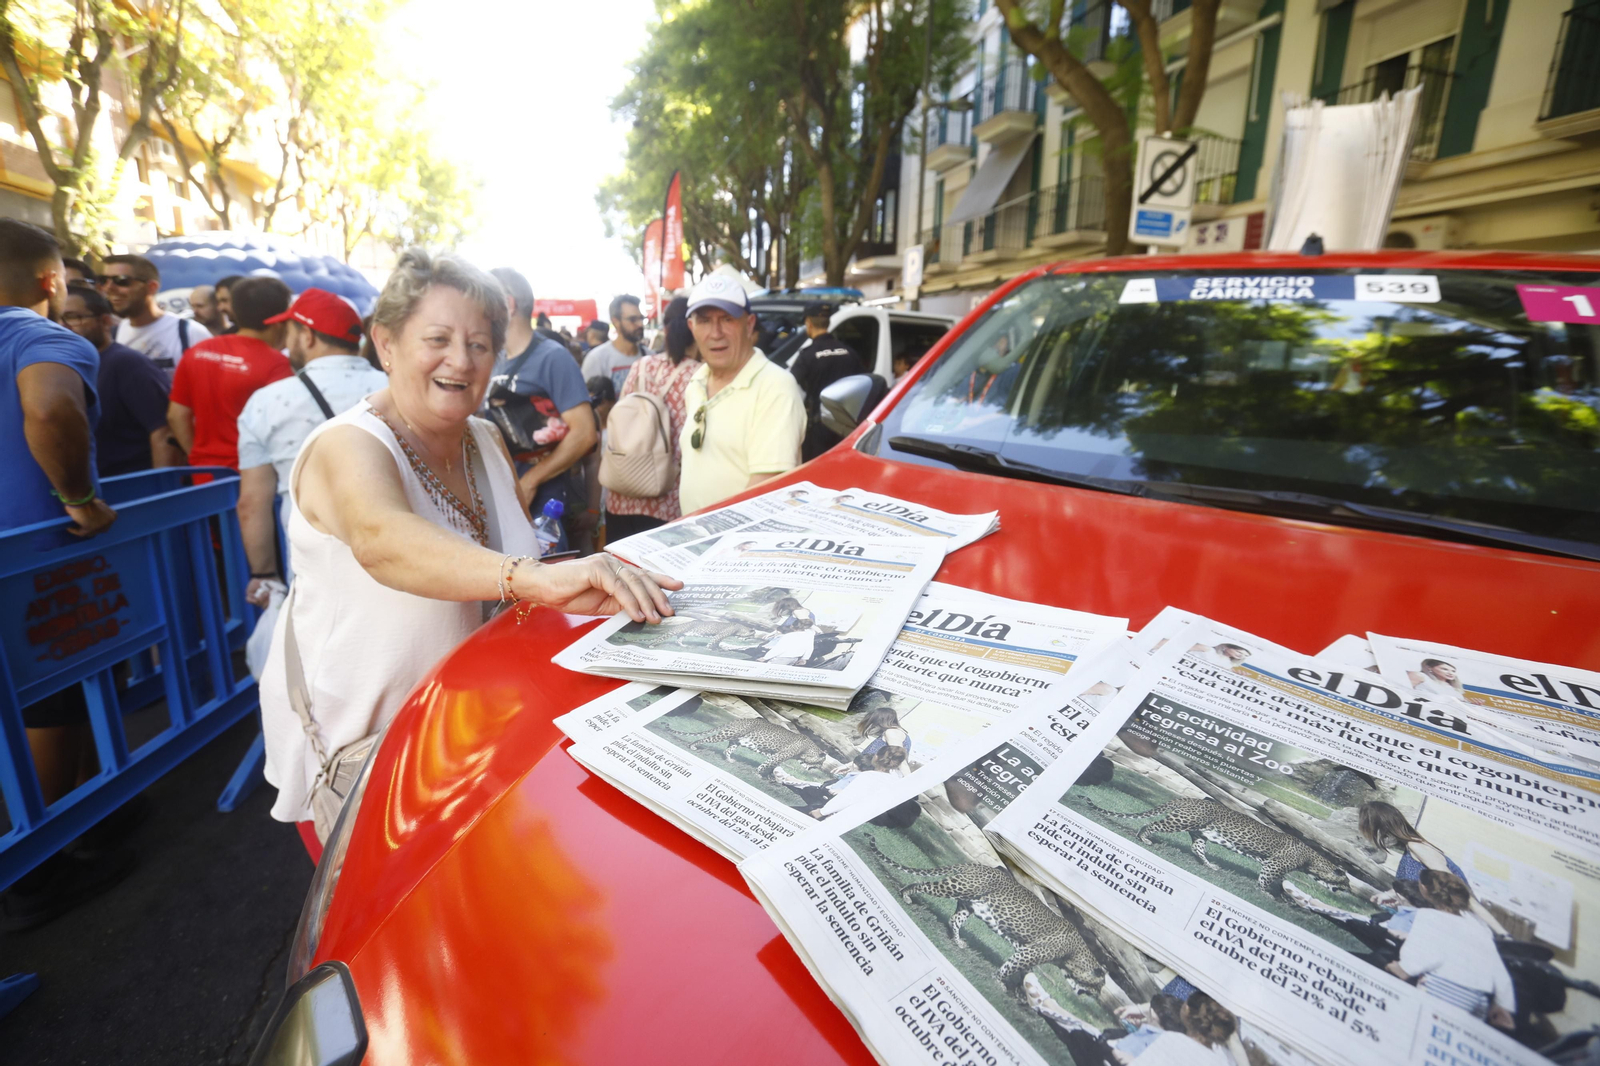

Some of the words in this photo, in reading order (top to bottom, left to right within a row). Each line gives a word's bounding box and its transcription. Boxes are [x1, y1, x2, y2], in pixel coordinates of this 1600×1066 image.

[1190, 288, 1315, 299] CARRERA
[1195, 277, 1314, 288] SERVICIO
[1366, 282, 1430, 294] 539
[1562, 294, 1596, 317] 1
[863, 501, 887, 513] el
[884, 505, 929, 524] Día
[776, 538, 809, 549] el
[805, 540, 865, 557] Día
[93, 573, 121, 597] DE
[802, 565, 824, 574] que
[836, 567, 906, 580] cogobierno
[27, 593, 129, 646] MONTILLA
[932, 612, 1012, 641] Día
[893, 659, 938, 678] fuerte
[938, 672, 968, 685] que
[968, 680, 1032, 698] nunca”
[919, 655, 948, 668] que
[948, 662, 966, 670] el
[1178, 657, 1198, 670] El
[1198, 667, 1268, 698] alcalde
[1271, 693, 1364, 734] defiende
[1368, 726, 1415, 751] que
[1418, 745, 1442, 760] el
[1287, 666, 1345, 695] el
[1347, 679, 1472, 736] Día
[1327, 694, 1348, 703] DE
[1351, 703, 1410, 724] CÓRDOBA
[1499, 673, 1568, 702] el
[1505, 700, 1532, 708] Ruta
[1148, 697, 1174, 714] La
[1177, 710, 1274, 753] actividad
[1494, 703, 1558, 720] Internacional
[1529, 719, 1560, 728] CRISIS
[610, 740, 626, 752] pide
[626, 747, 636, 756] el
[634, 751, 661, 772] indulto
[660, 768, 672, 780] sin
[621, 734, 631, 743] La
[630, 739, 656, 757] familia
[655, 754, 666, 762] de
[664, 758, 693, 778] Griñán
[997, 748, 1021, 767] La
[1126, 728, 1151, 742] acoge
[1158, 740, 1171, 749] los
[1171, 747, 1210, 766] primeros
[1212, 763, 1256, 787] visitantes
[1131, 722, 1174, 744] instalación
[1174, 739, 1202, 755] reabre
[1203, 751, 1219, 763] sus
[1219, 759, 1256, 778] puertas
[1256, 774, 1263, 782] y
[1140, 708, 1220, 747] regresa
[1223, 743, 1244, 758] al
[1248, 750, 1295, 776] Zoo
[1141, 719, 1159, 730] Tres
[1159, 727, 1186, 739] meses
[1226, 754, 1235, 763] la
[1171, 665, 1217, 688] “está
[1220, 685, 1282, 713] ahora
[1286, 711, 1335, 733] más
[1338, 727, 1412, 763] fuerte
[1417, 759, 1469, 781] que
[1474, 777, 1587, 815] nunca”
[602, 745, 630, 764] esperar
[627, 760, 637, 768] la
[635, 766, 672, 791] sentencia
[956, 777, 978, 794] acoge
[983, 795, 994, 806] los
[964, 771, 1001, 800] instalación
[977, 770, 992, 783] Tres
[992, 781, 1016, 799] meses
[686, 799, 720, 820] octubre
[718, 817, 736, 829] del
[732, 826, 752, 840] 21%
[750, 837, 761, 848] al
[696, 792, 706, 800] el
[705, 795, 720, 810] IVA
[720, 806, 736, 818] del
[735, 816, 750, 828] gas
[750, 822, 778, 843] desde
[705, 783, 715, 793] El
[715, 788, 756, 817] Gobierno
[754, 814, 795, 838] rebajará
[1056, 812, 1084, 830] ESGRIME
[1027, 830, 1076, 863] esperar
[1076, 859, 1089, 872] la
[1090, 869, 1158, 915] sentencia
[1033, 821, 1063, 842] pide
[1063, 840, 1077, 851] el
[1076, 846, 1125, 880] indulto
[1125, 877, 1148, 895] sin
[1041, 813, 1058, 827] La
[1058, 823, 1104, 855] familia
[1105, 852, 1123, 866] de
[1124, 863, 1175, 897] Griñán
[783, 861, 820, 901] esperar
[815, 899, 829, 915] la
[825, 914, 874, 977] sentencia
[794, 854, 819, 876] pide
[816, 875, 831, 888] el
[824, 886, 861, 932] indulto
[858, 931, 878, 954] sin
[809, 847, 824, 861] La
[821, 859, 856, 900] familia
[853, 900, 869, 916] de
[866, 915, 905, 962] Griñán
[1199, 919, 1215, 931] el
[1216, 927, 1245, 949] IVA
[1248, 943, 1276, 965] del
[1275, 962, 1310, 984] gas
[1311, 978, 1367, 1016] desde
[1205, 906, 1223, 921] El
[1225, 916, 1305, 963] Gobierno
[1307, 962, 1388, 1012] rebajará
[1210, 898, 1221, 907] 20
[1221, 904, 1258, 925] SÁNCHEZ
[1259, 923, 1271, 932] NO
[1271, 929, 1323, 959] CONTEMPLA
[1323, 956, 1400, 1000] RESTRICCIONES
[936, 976, 946, 986] 20
[944, 985, 972, 1016] SÁNCHEZ
[971, 1015, 981, 1026] NO
[1193, 931, 1258, 971] octubre
[1260, 965, 1289, 988] del
[1290, 983, 1326, 1011] 21%
[1328, 1008, 1349, 1023] al
[1349, 1018, 1382, 1043] 5%
[894, 1005, 944, 1061] octubre
[909, 995, 927, 1010] el
[920, 1008, 946, 1037] IVA
[944, 1035, 970, 1059] del
[922, 983, 942, 1002] El
[936, 1000, 998, 1066] Gobierno
